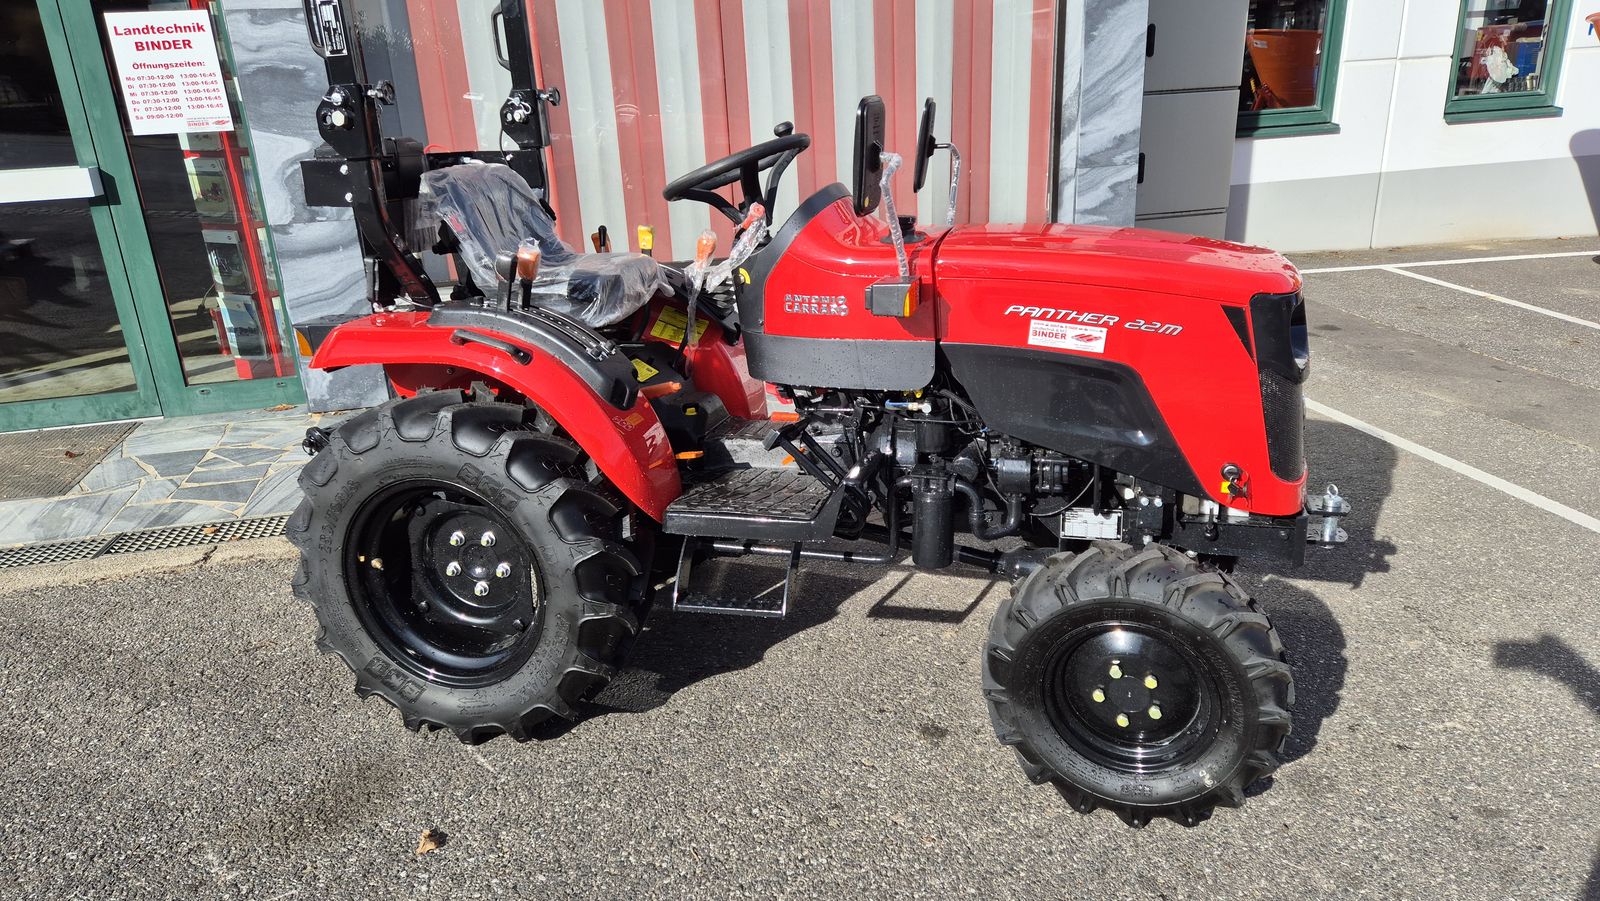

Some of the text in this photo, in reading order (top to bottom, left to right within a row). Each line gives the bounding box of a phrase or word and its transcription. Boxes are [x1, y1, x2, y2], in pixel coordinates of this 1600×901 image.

[113, 22, 206, 36] Landtechnik
[134, 39, 193, 52] BINDER
[132, 60, 205, 71] Öffnungszeiten:
[784, 294, 846, 304] ANTONIO
[784, 302, 848, 316] CARRARO
[1004, 305, 1120, 326] PANTHER
[1124, 319, 1184, 336] 22M
[1031, 329, 1067, 340] BINDER
